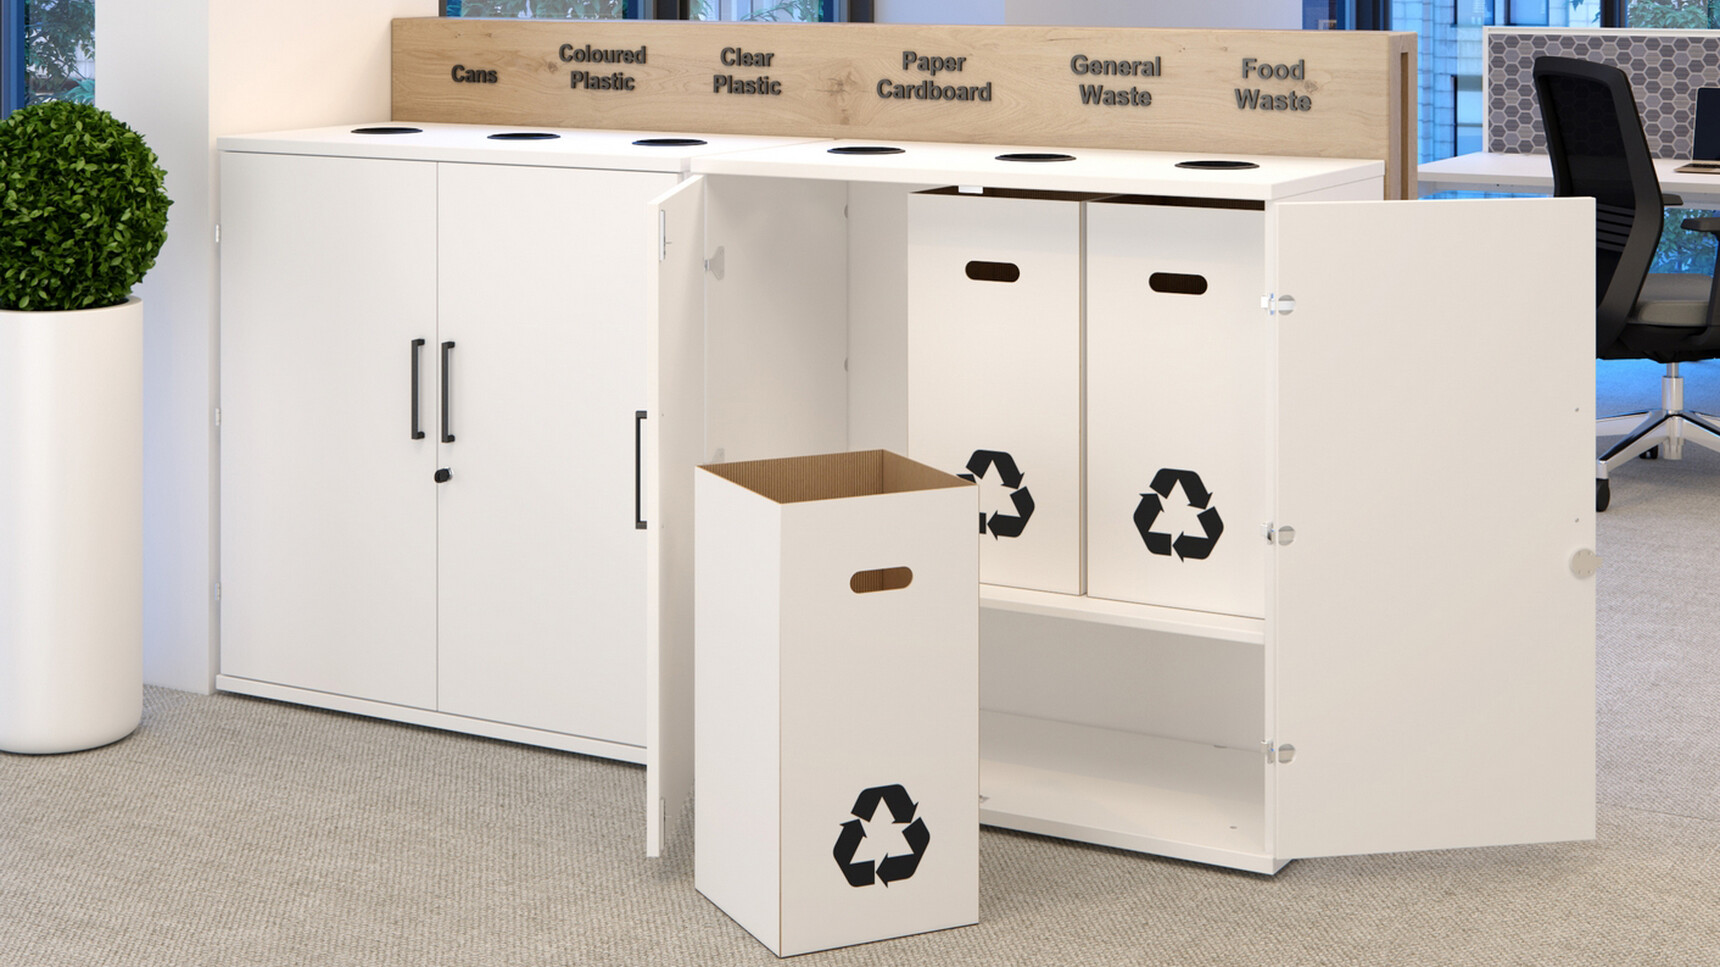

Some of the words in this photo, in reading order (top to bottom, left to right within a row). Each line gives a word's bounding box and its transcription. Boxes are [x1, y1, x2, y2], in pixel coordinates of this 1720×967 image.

[559, 44, 646, 64] Coloured
[721, 48, 774, 67] Clear
[903, 52, 966, 76] Paper
[451, 65, 498, 84] Cans
[1071, 55, 1161, 76] General
[1243, 59, 1304, 80] Food
[571, 71, 635, 91] Plastic
[714, 75, 781, 95] Plastic
[877, 79, 991, 101] Cardboard
[1080, 84, 1151, 106] Waste
[1235, 89, 1311, 111] Waste
